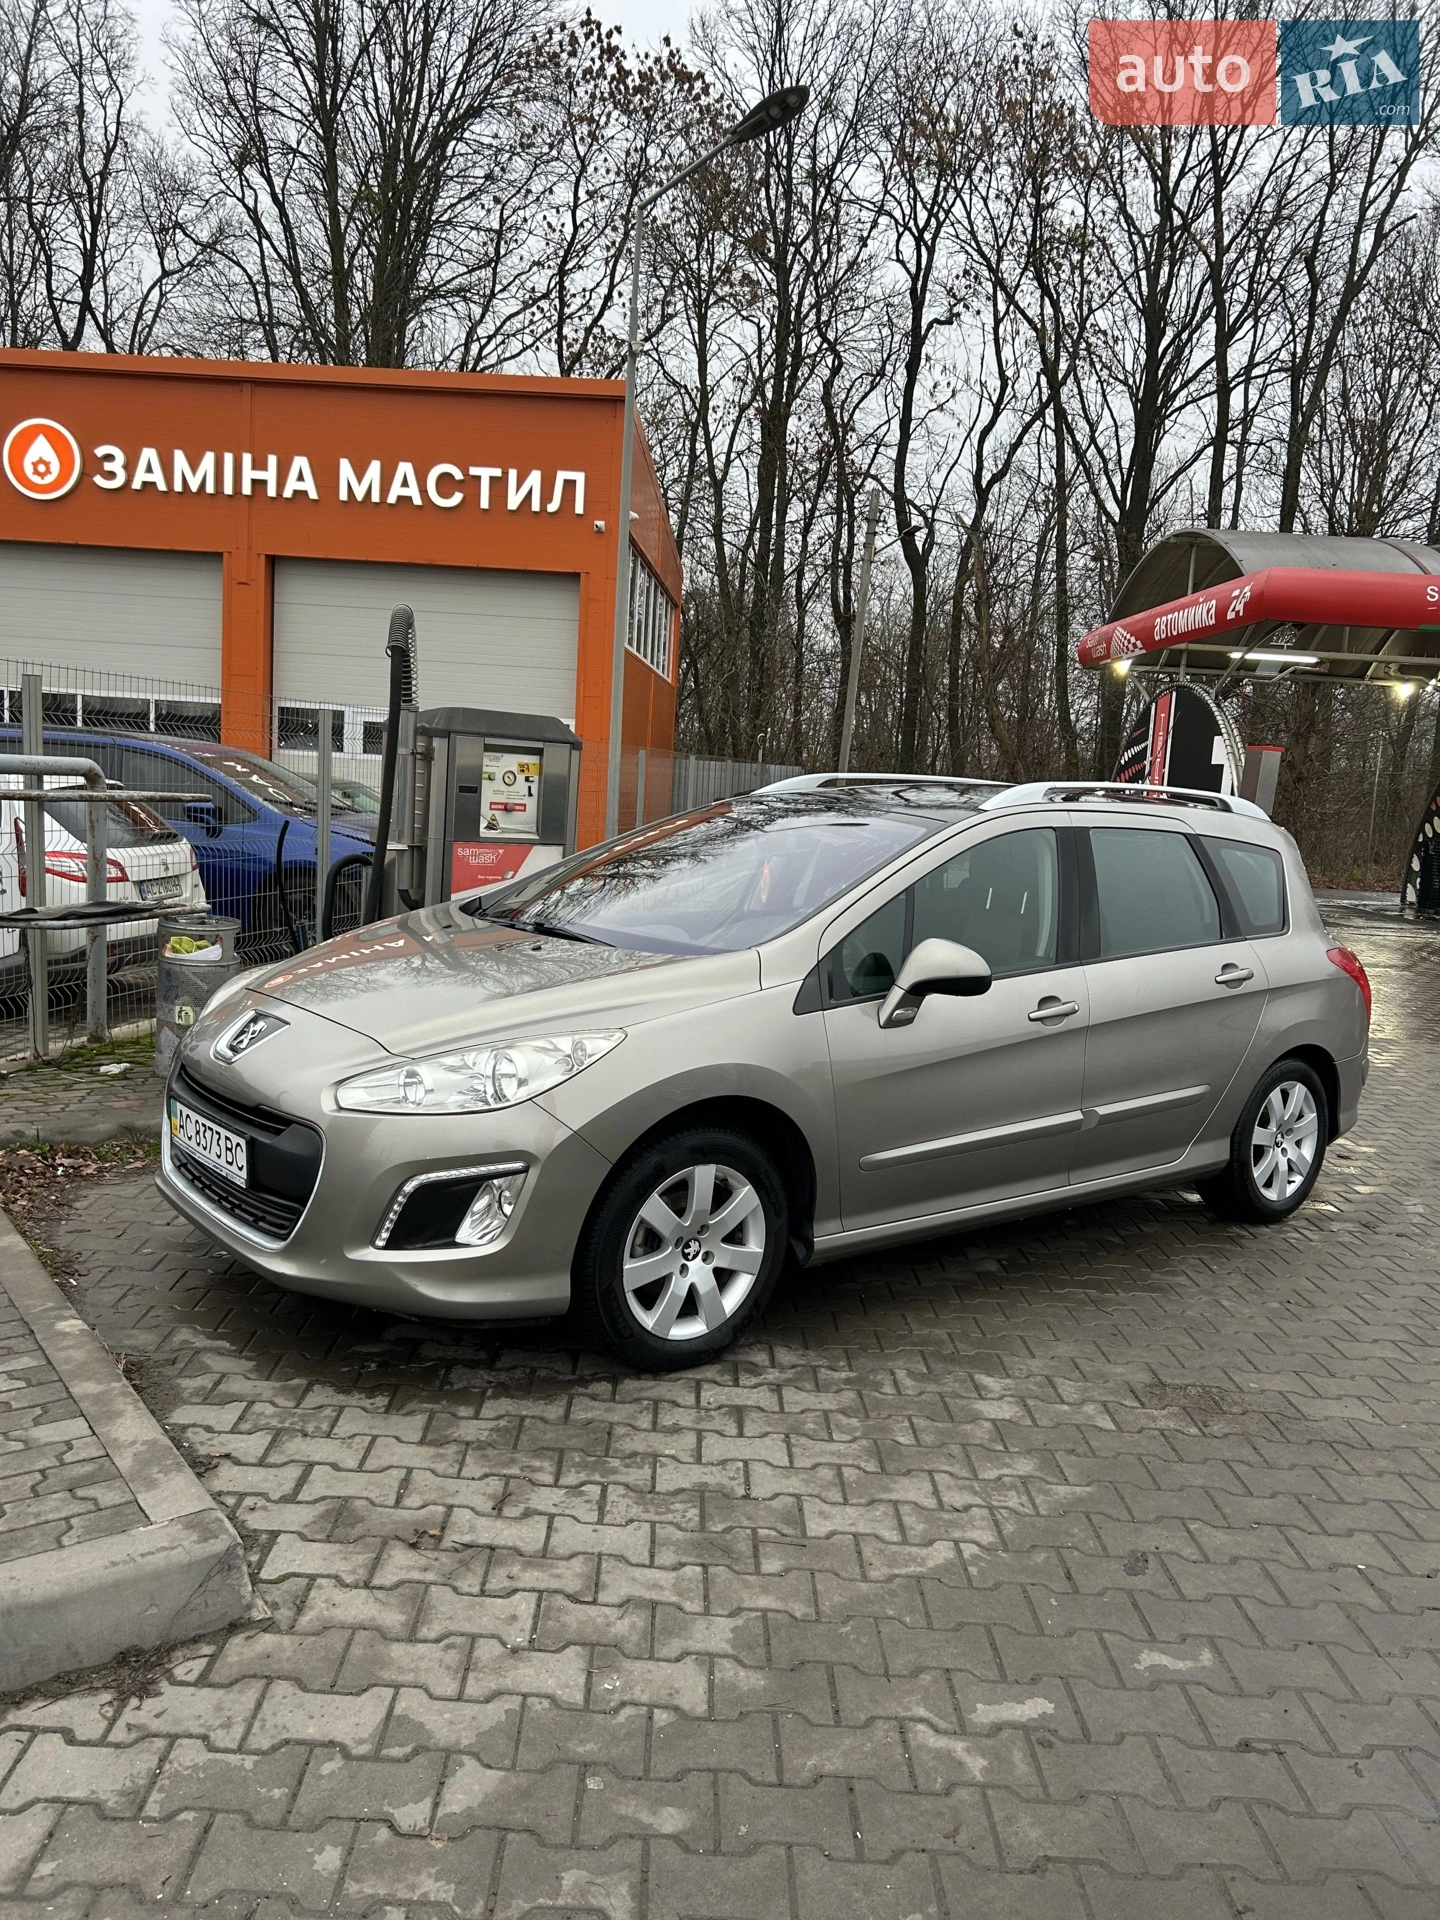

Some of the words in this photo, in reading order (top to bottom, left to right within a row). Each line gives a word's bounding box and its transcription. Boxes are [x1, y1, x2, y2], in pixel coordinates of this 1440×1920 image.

[92, 444, 319, 500] ЗАМІНА
[337, 457, 586, 515] МАСТИЛ
[1154, 595, 1217, 642] автомийка
[457, 847, 479, 856] sam
[469, 853, 497, 864] wash
[178, 1108, 193, 1141] AC
[194, 1118, 222, 1160] 8373
[224, 1134, 244, 1172] BC
